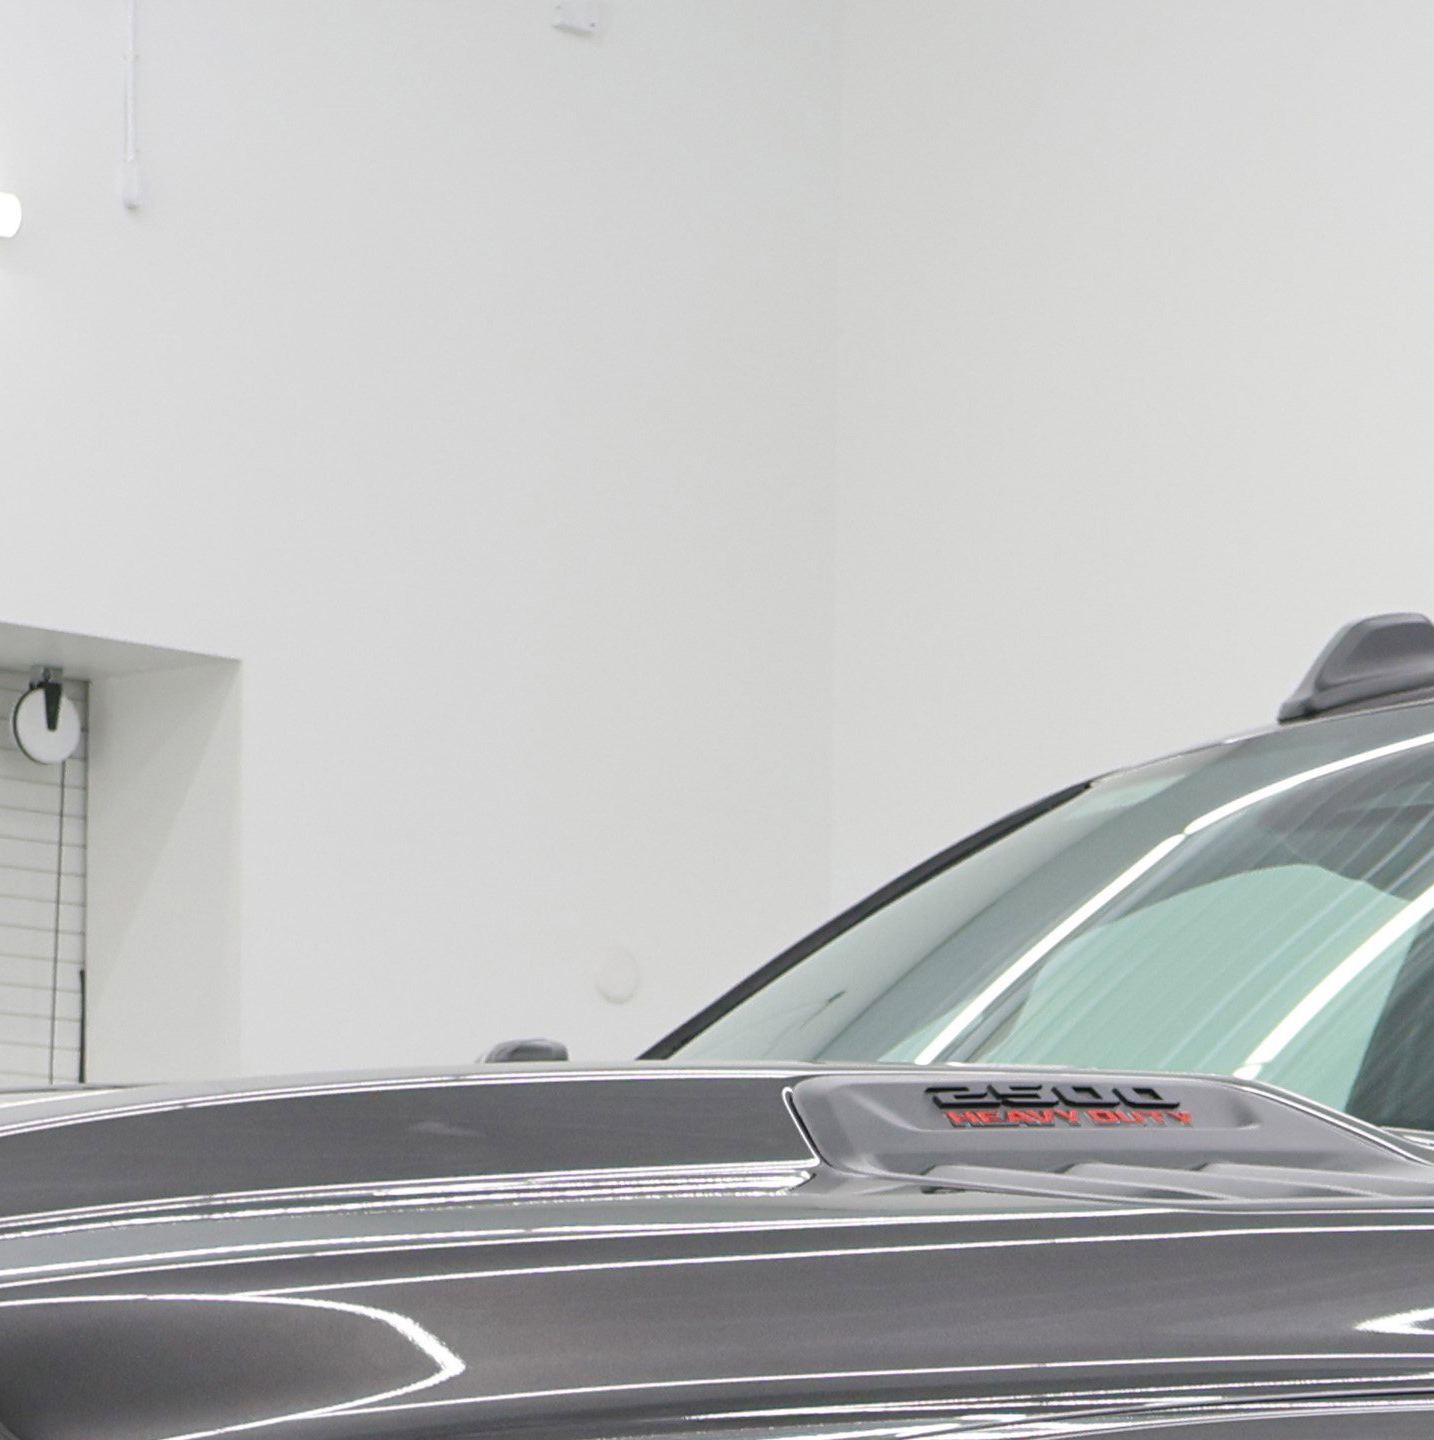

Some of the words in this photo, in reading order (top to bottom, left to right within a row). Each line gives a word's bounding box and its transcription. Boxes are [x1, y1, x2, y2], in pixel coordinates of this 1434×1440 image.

[924, 1084, 1180, 1109] 2500
[943, 1110, 1080, 1127] HEAVY
[1084, 1110, 1193, 1127] DUTY
